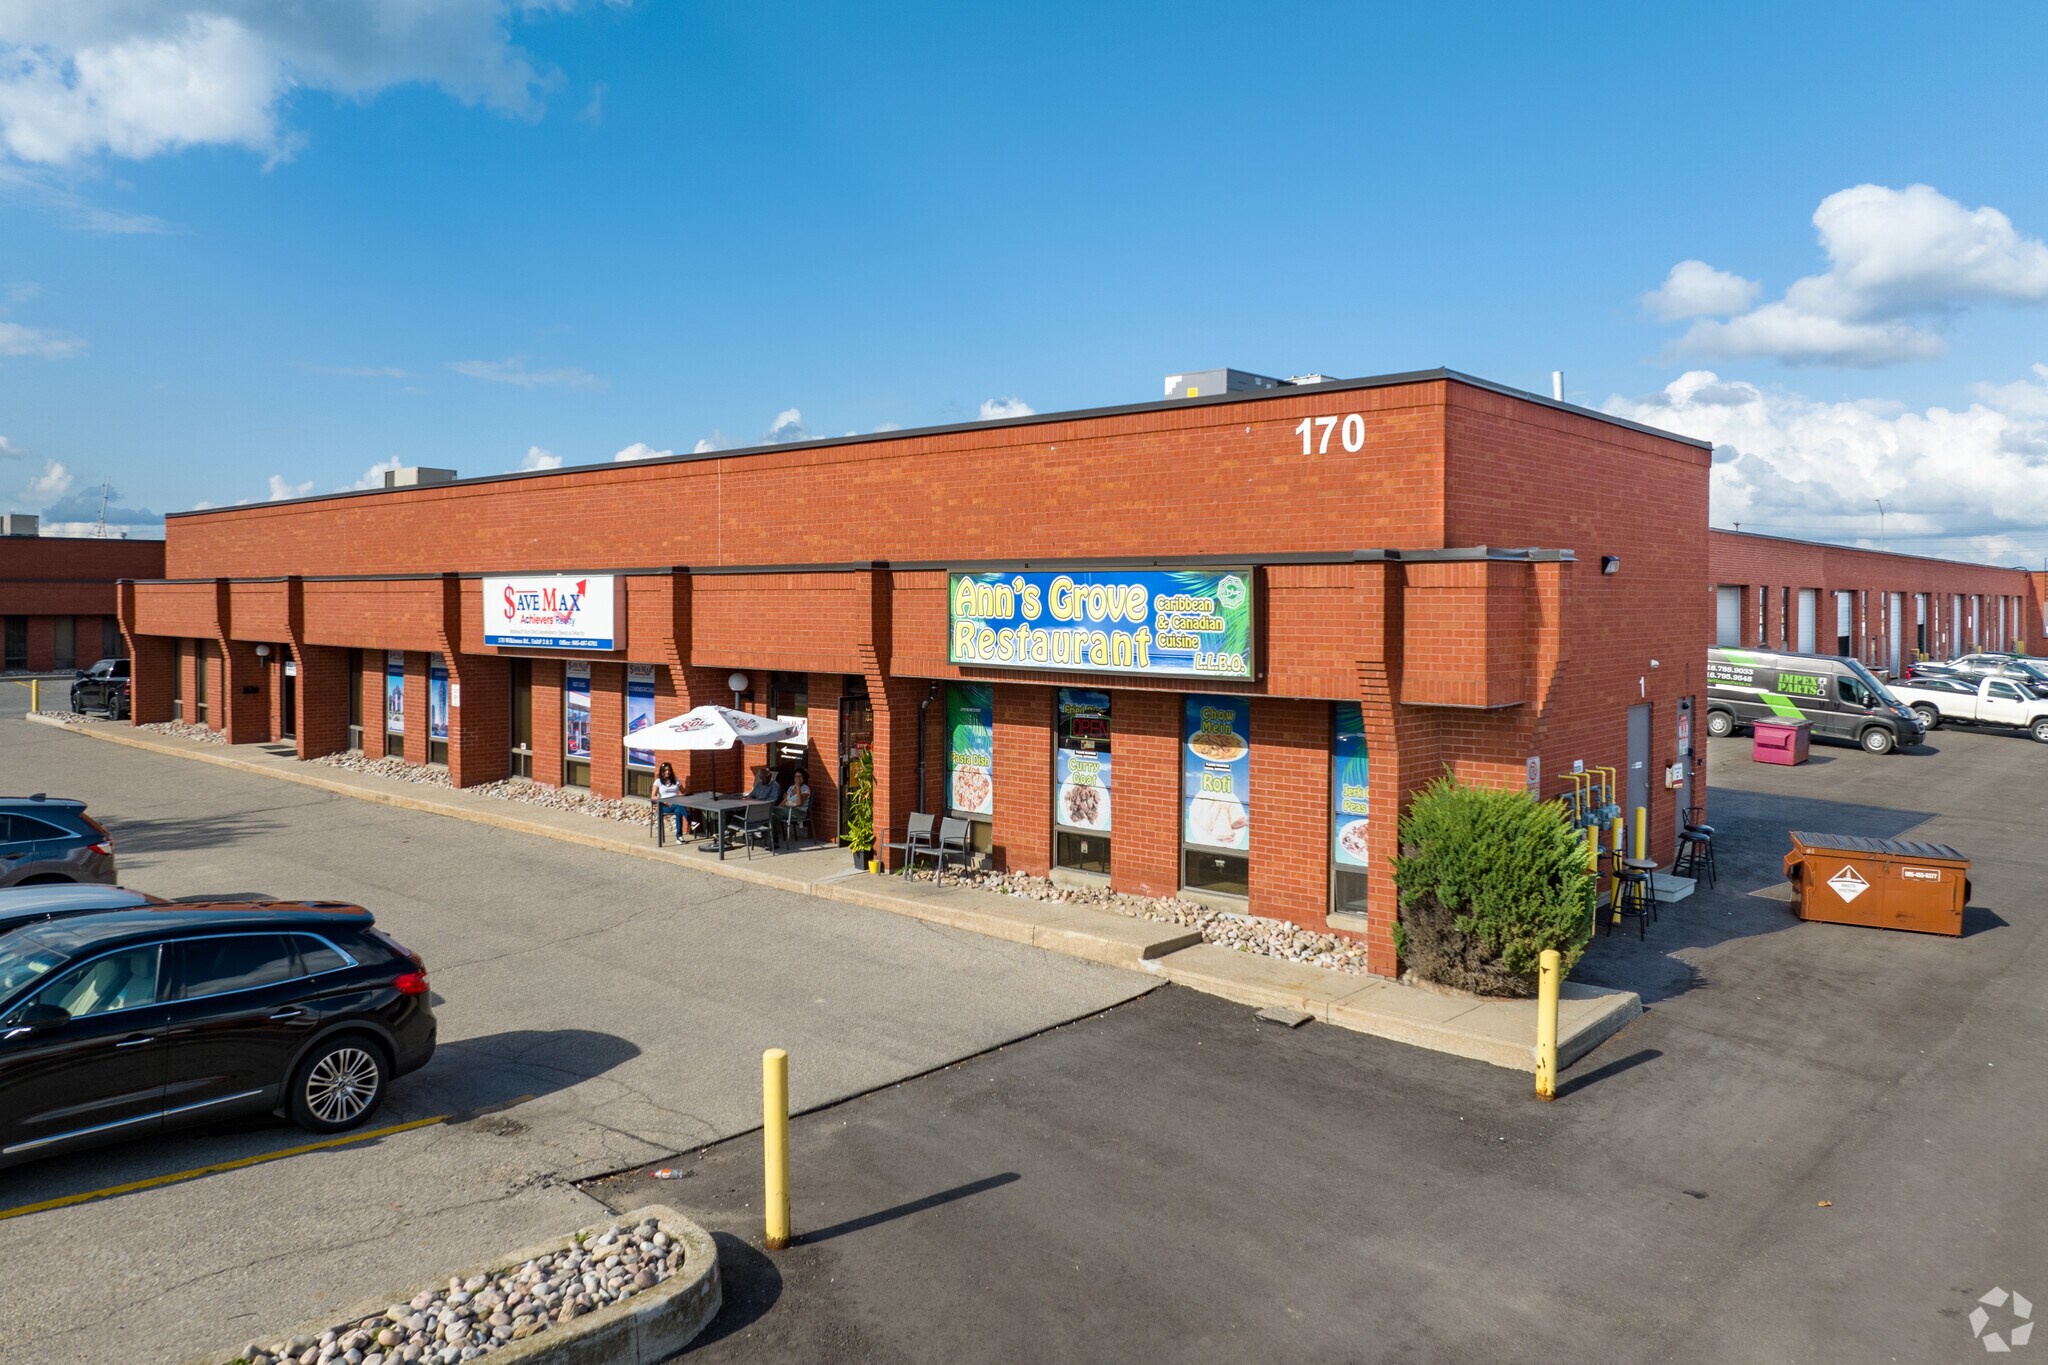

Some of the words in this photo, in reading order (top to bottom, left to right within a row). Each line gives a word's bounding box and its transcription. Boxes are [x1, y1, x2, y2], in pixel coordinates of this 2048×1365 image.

[1295, 413, 1365, 456] 170
[954, 575, 1041, 618] Ann's
[1049, 576, 1148, 621] Grove
[1155, 595, 1213, 614] Caribbean
[520, 614, 554, 625] Achievers
[1157, 614, 1169, 631] &
[1172, 614, 1224, 632] Canadian
[954, 621, 1152, 668] Restaurant
[1157, 632, 1200, 650] Cuisine
[1195, 653, 1246, 673] L.L.B.O.
[1778, 673, 1817, 686] IMPEX
[1777, 683, 1818, 695] PARTS
[1201, 706, 1235, 721] Chow
[1072, 719, 1110, 738] OPEN
[1201, 720, 1232, 734] Mein
[951, 752, 971, 765] Pasta
[972, 754, 990, 767] Dish
[1069, 758, 1099, 773] Curry
[1072, 772, 1097, 786] Goat
[1202, 773, 1232, 793] Roti
[1343, 785, 1364, 798] Jerk
[1343, 799, 1367, 814] Peas
